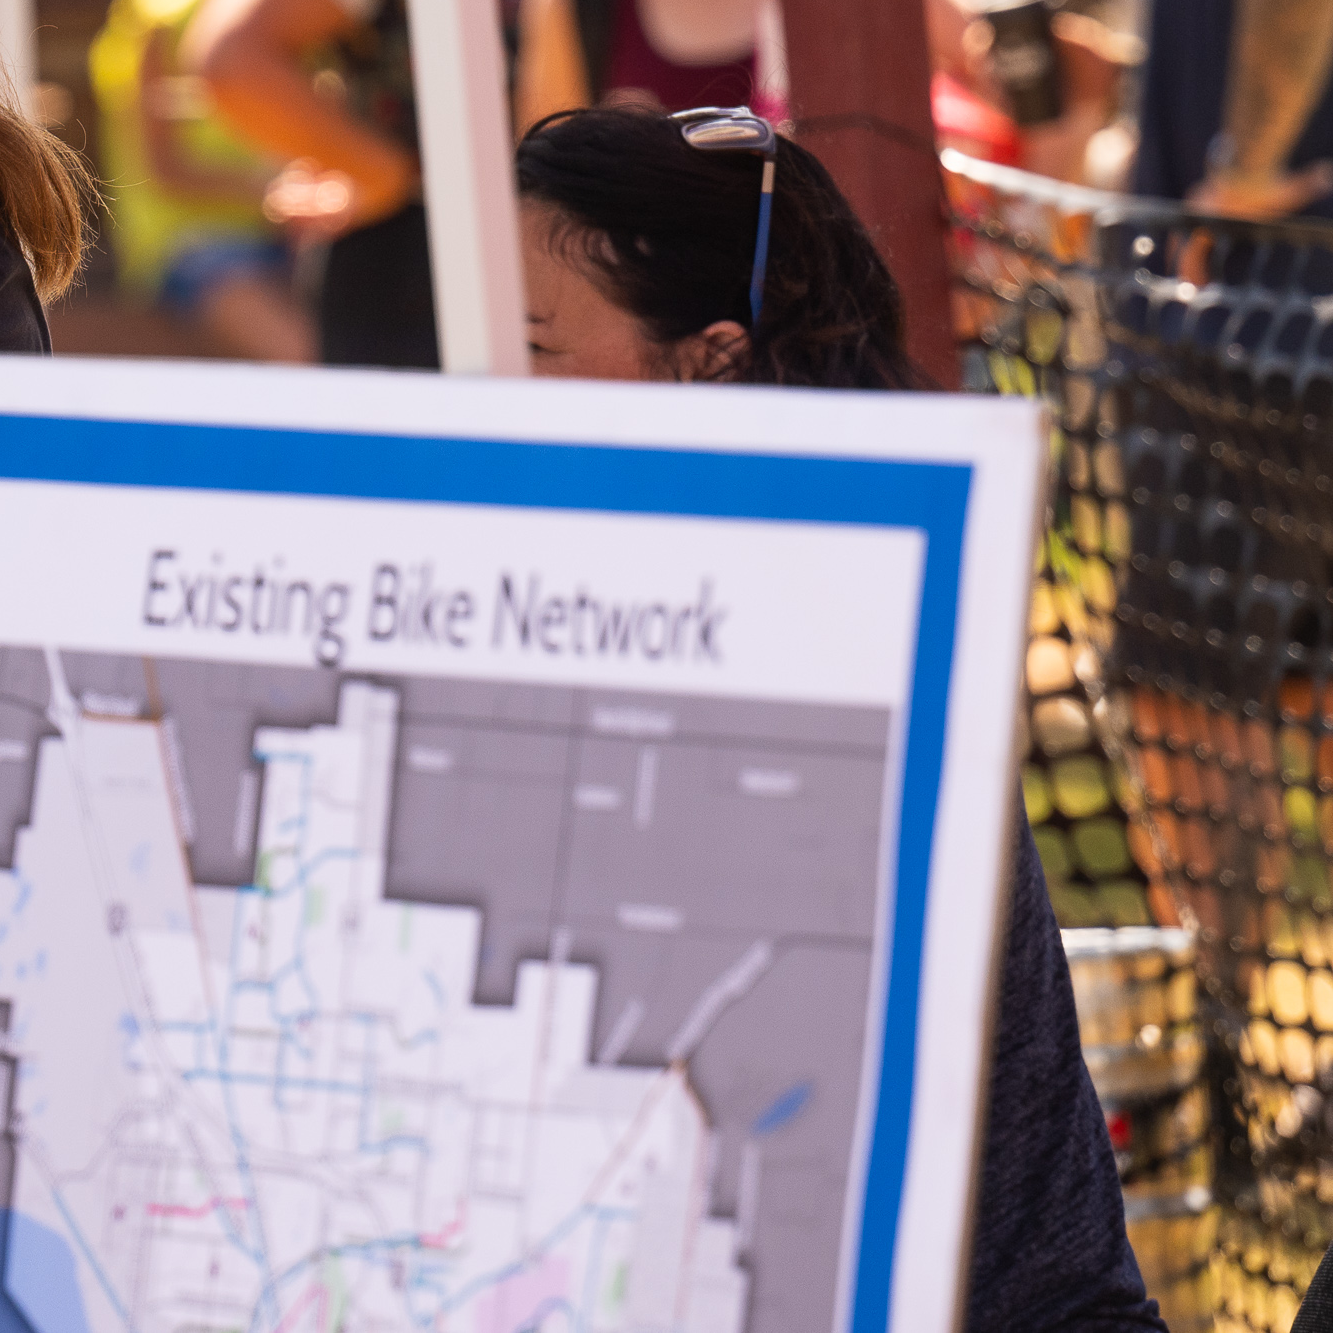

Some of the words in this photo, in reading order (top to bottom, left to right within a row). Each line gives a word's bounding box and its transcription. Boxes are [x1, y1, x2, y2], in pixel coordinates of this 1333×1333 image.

[142, 548, 351, 668] Existing
[367, 560, 474, 649] Bike
[490, 570, 728, 664] Network
